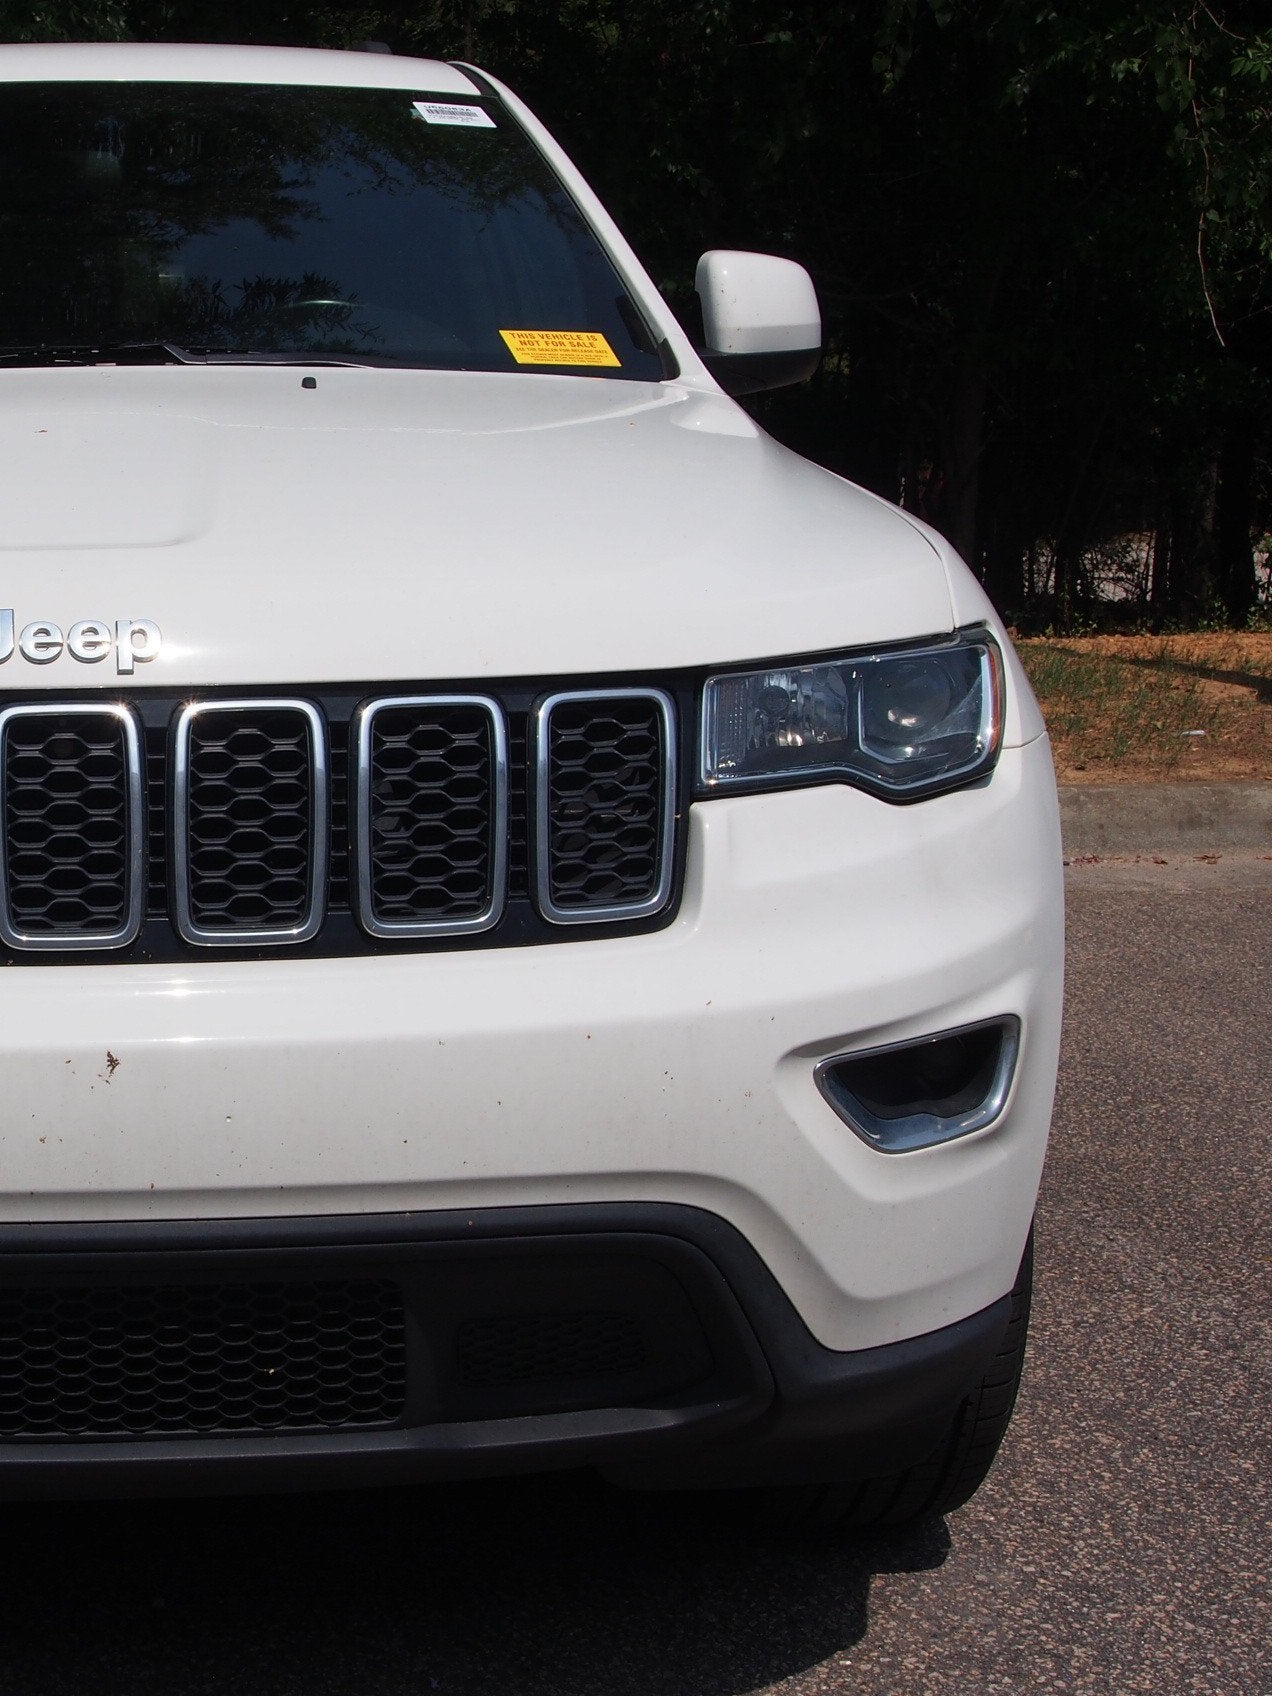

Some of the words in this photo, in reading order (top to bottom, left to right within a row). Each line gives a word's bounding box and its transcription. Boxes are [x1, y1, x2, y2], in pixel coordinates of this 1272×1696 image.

[509, 332, 536, 340] THIS
[538, 333, 584, 341] VEHICLE
[545, 340, 567, 348] FOR
[569, 341, 597, 349] SALE
